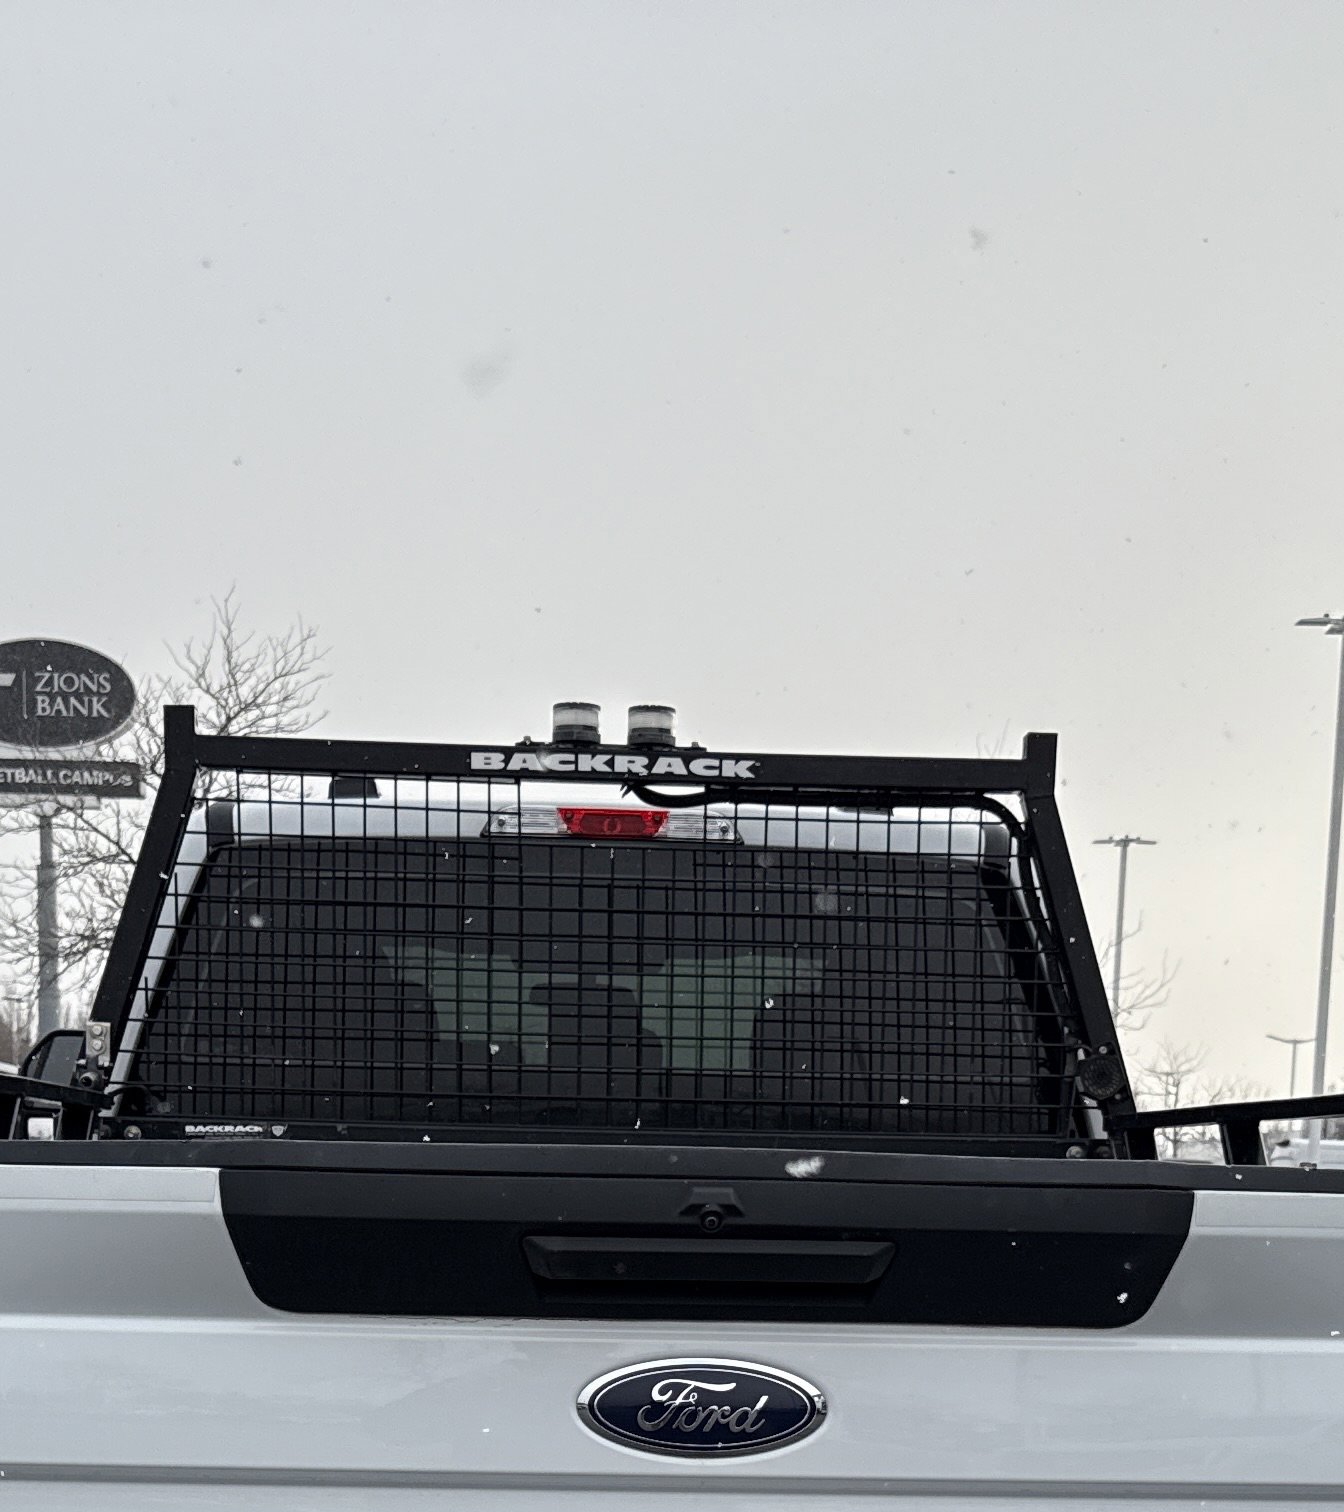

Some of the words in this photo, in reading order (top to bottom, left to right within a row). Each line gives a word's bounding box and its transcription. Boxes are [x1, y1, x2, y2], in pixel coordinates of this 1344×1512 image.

[34, 672, 112, 694] ZIONS
[35, 696, 111, 718] BANK
[470, 752, 756, 778] BACKRACK
[185, 1125, 264, 1133] BACKRAC
[636, 1378, 769, 1433] Ford
